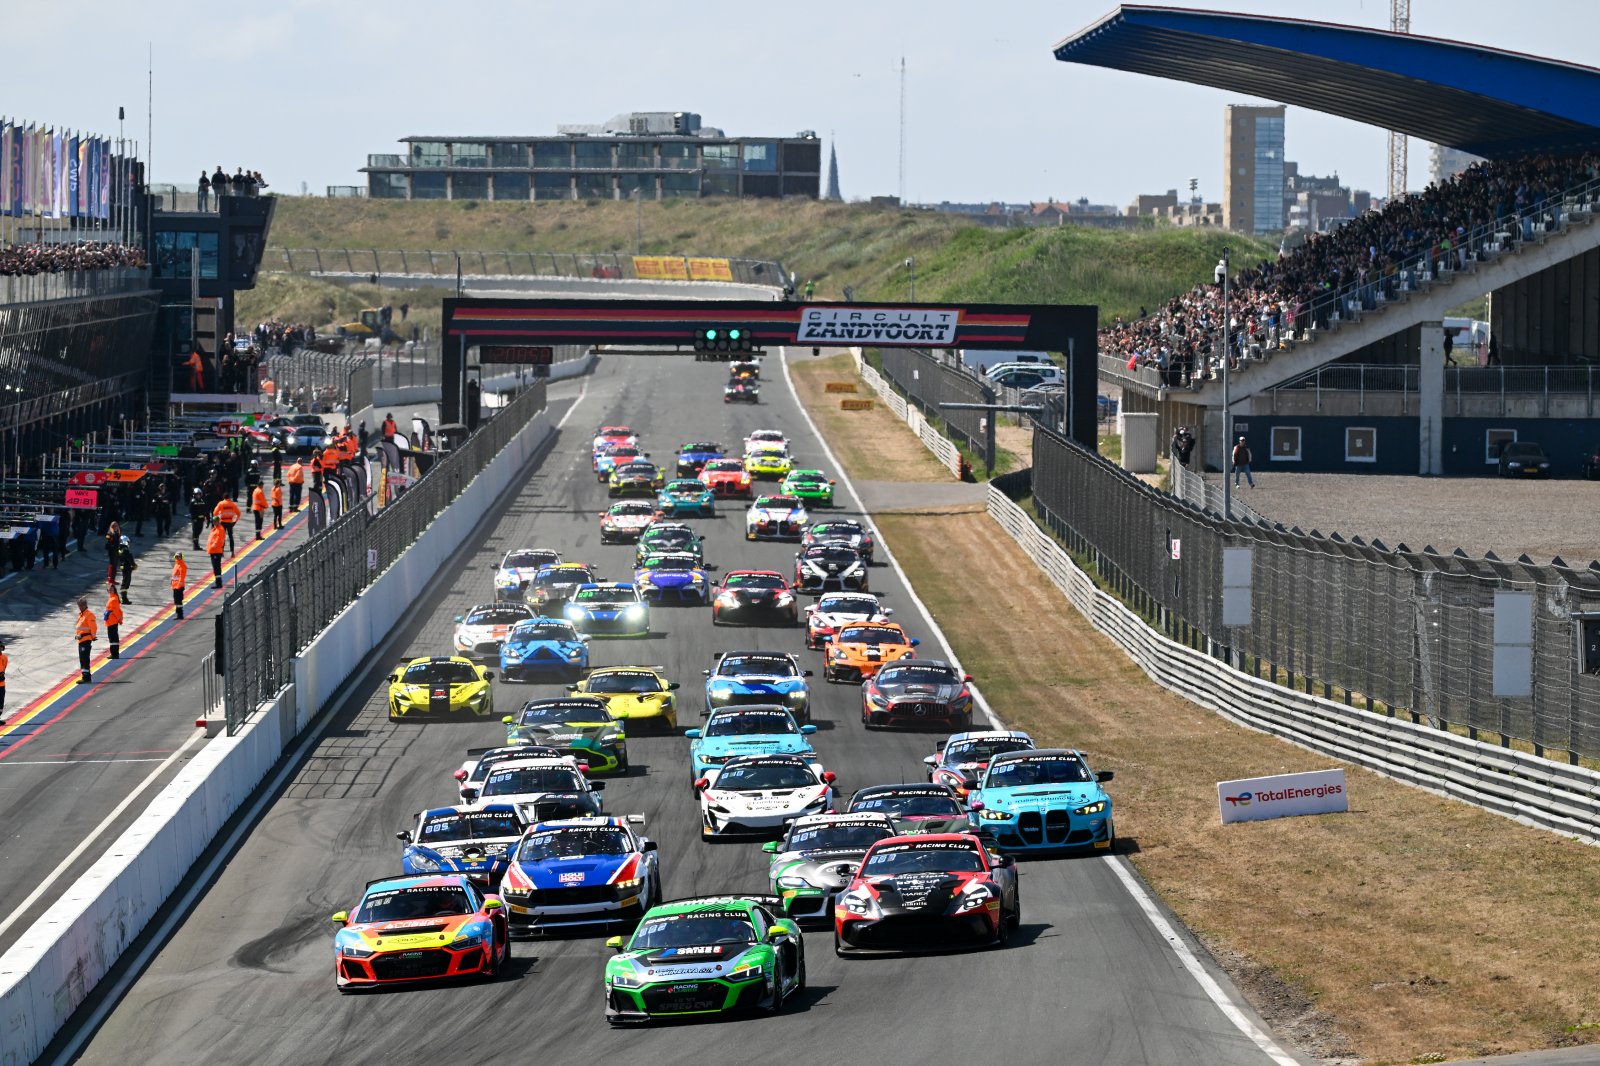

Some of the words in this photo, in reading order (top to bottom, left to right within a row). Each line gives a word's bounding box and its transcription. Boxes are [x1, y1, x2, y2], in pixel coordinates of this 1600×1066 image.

[809, 312, 951, 322] CIRCUIT
[805, 322, 949, 340] ZANDVOORT
[1255, 784, 1342, 802] TotalEnergies
[687, 911, 722, 919] RACING
